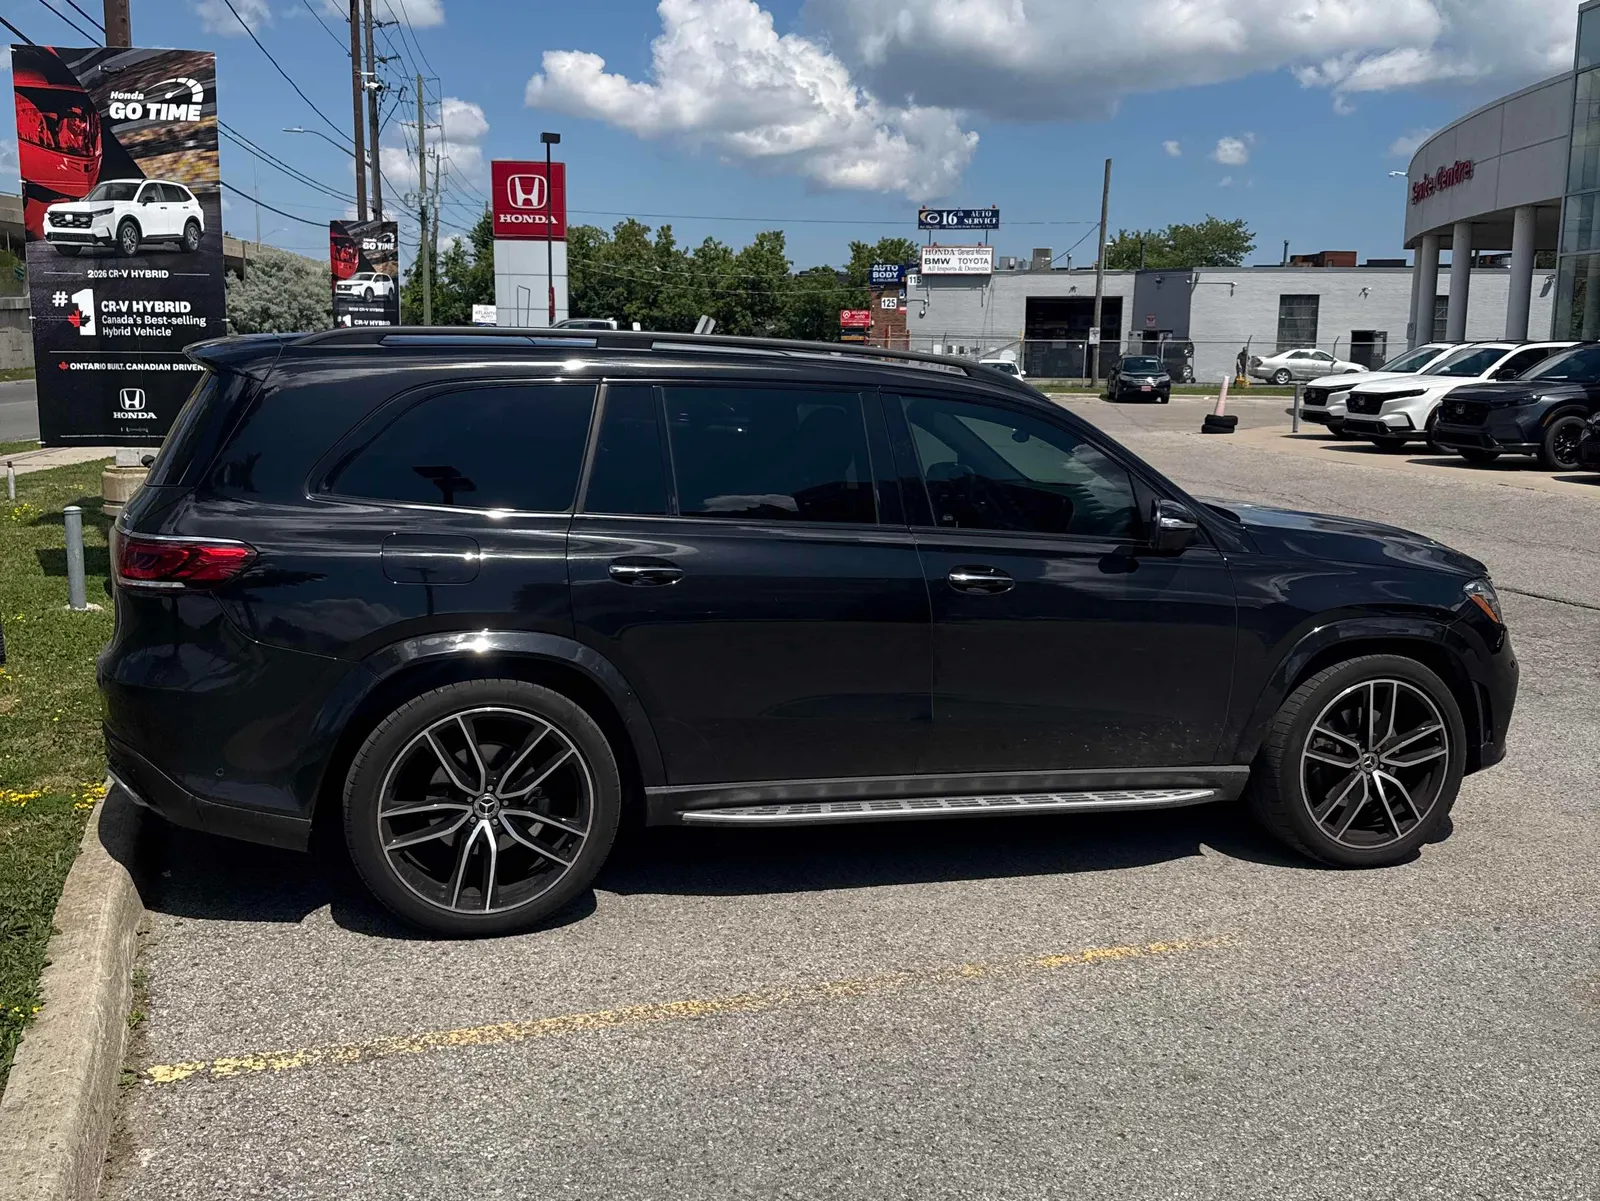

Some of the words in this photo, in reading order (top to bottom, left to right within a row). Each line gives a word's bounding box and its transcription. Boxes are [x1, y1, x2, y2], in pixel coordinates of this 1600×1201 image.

[110, 91, 144, 100] Honda
[109, 101, 143, 120] GO
[146, 103, 202, 121] TIME
[499, 214, 558, 224] HONDA
[108, 270, 128, 278] CR-V
[131, 270, 169, 278] HYBRID
[909, 275, 922, 284] 115
[101, 300, 129, 312] CR-V
[132, 301, 192, 313] HYBRID
[882, 298, 896, 308] 125
[102, 314, 142, 324] Canada's
[144, 315, 206, 327] Best-selling
[102, 326, 131, 338] Hybrid
